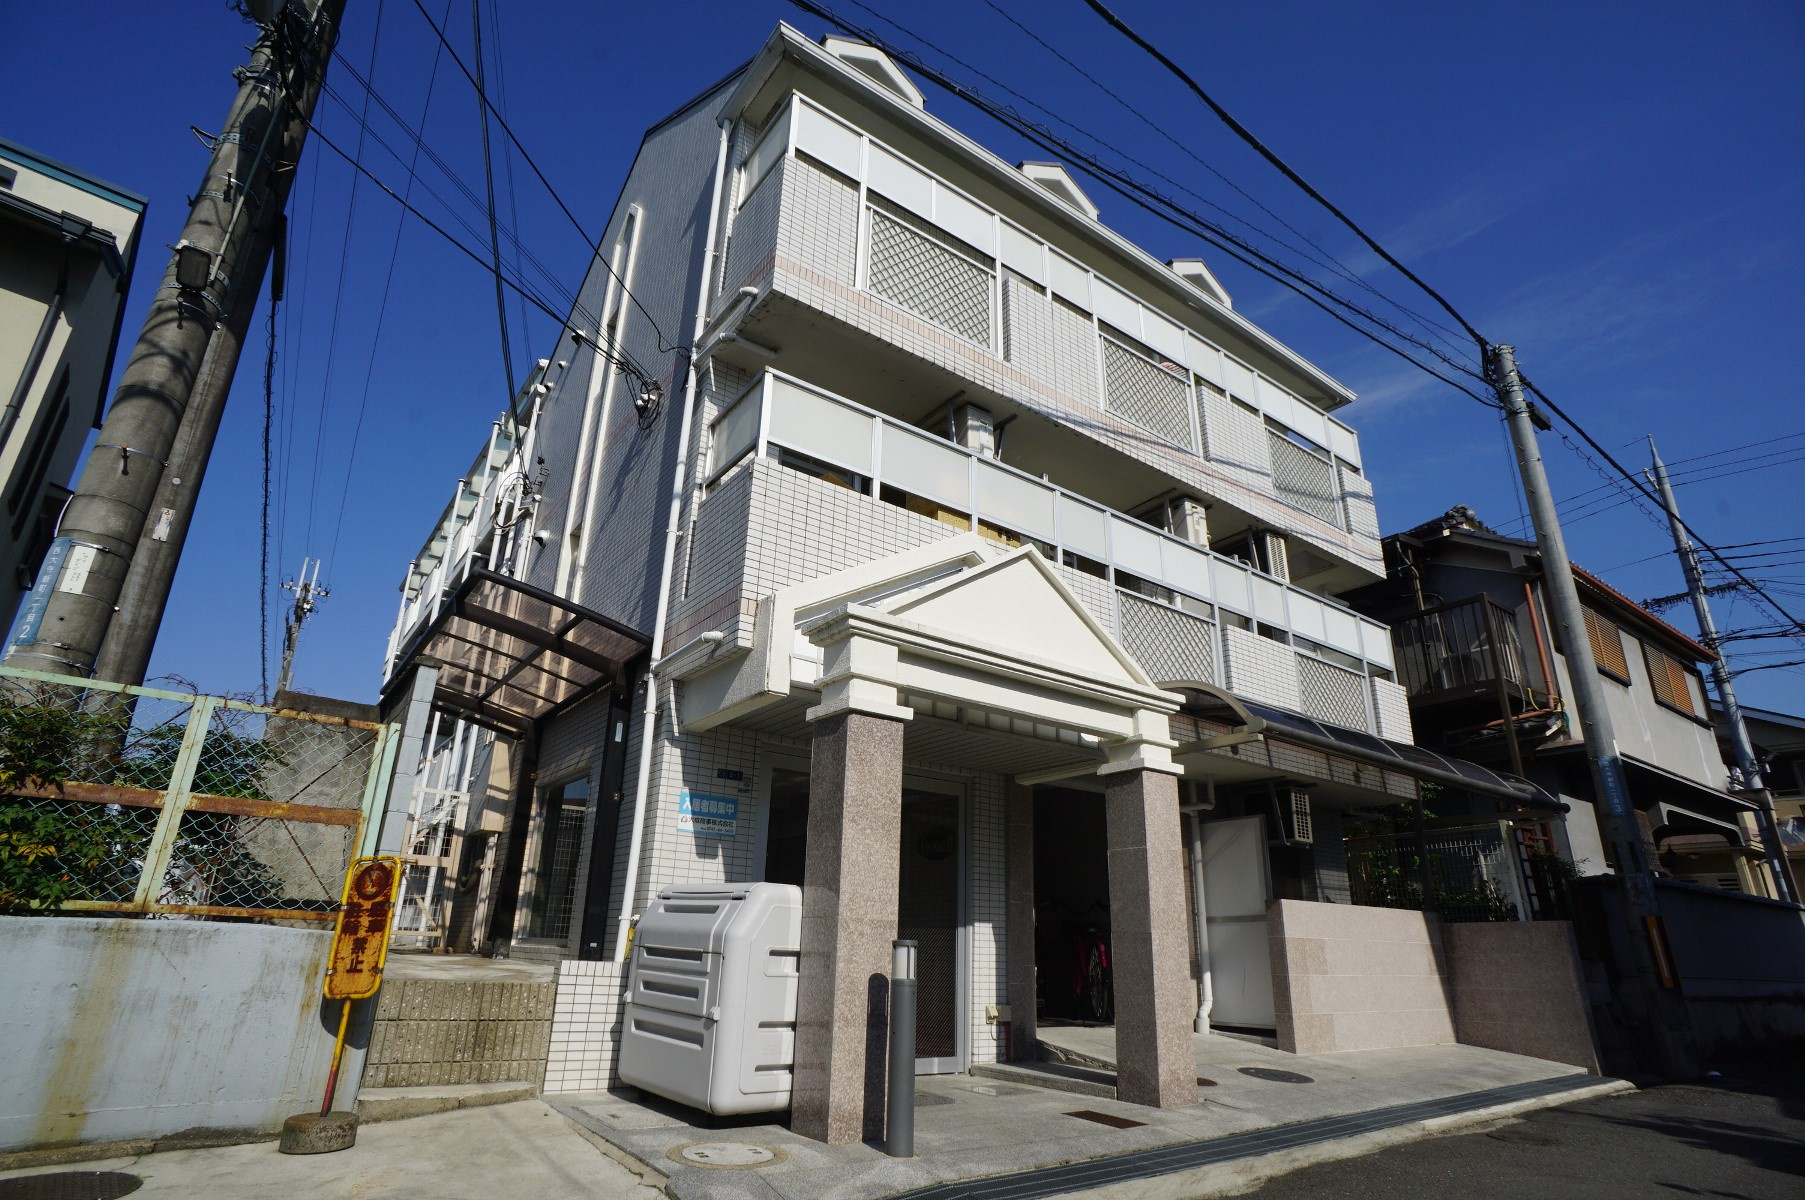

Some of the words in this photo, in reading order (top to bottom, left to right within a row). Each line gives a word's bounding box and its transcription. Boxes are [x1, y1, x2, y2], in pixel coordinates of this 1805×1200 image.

[683, 797, 735, 815] 入居者募集中
